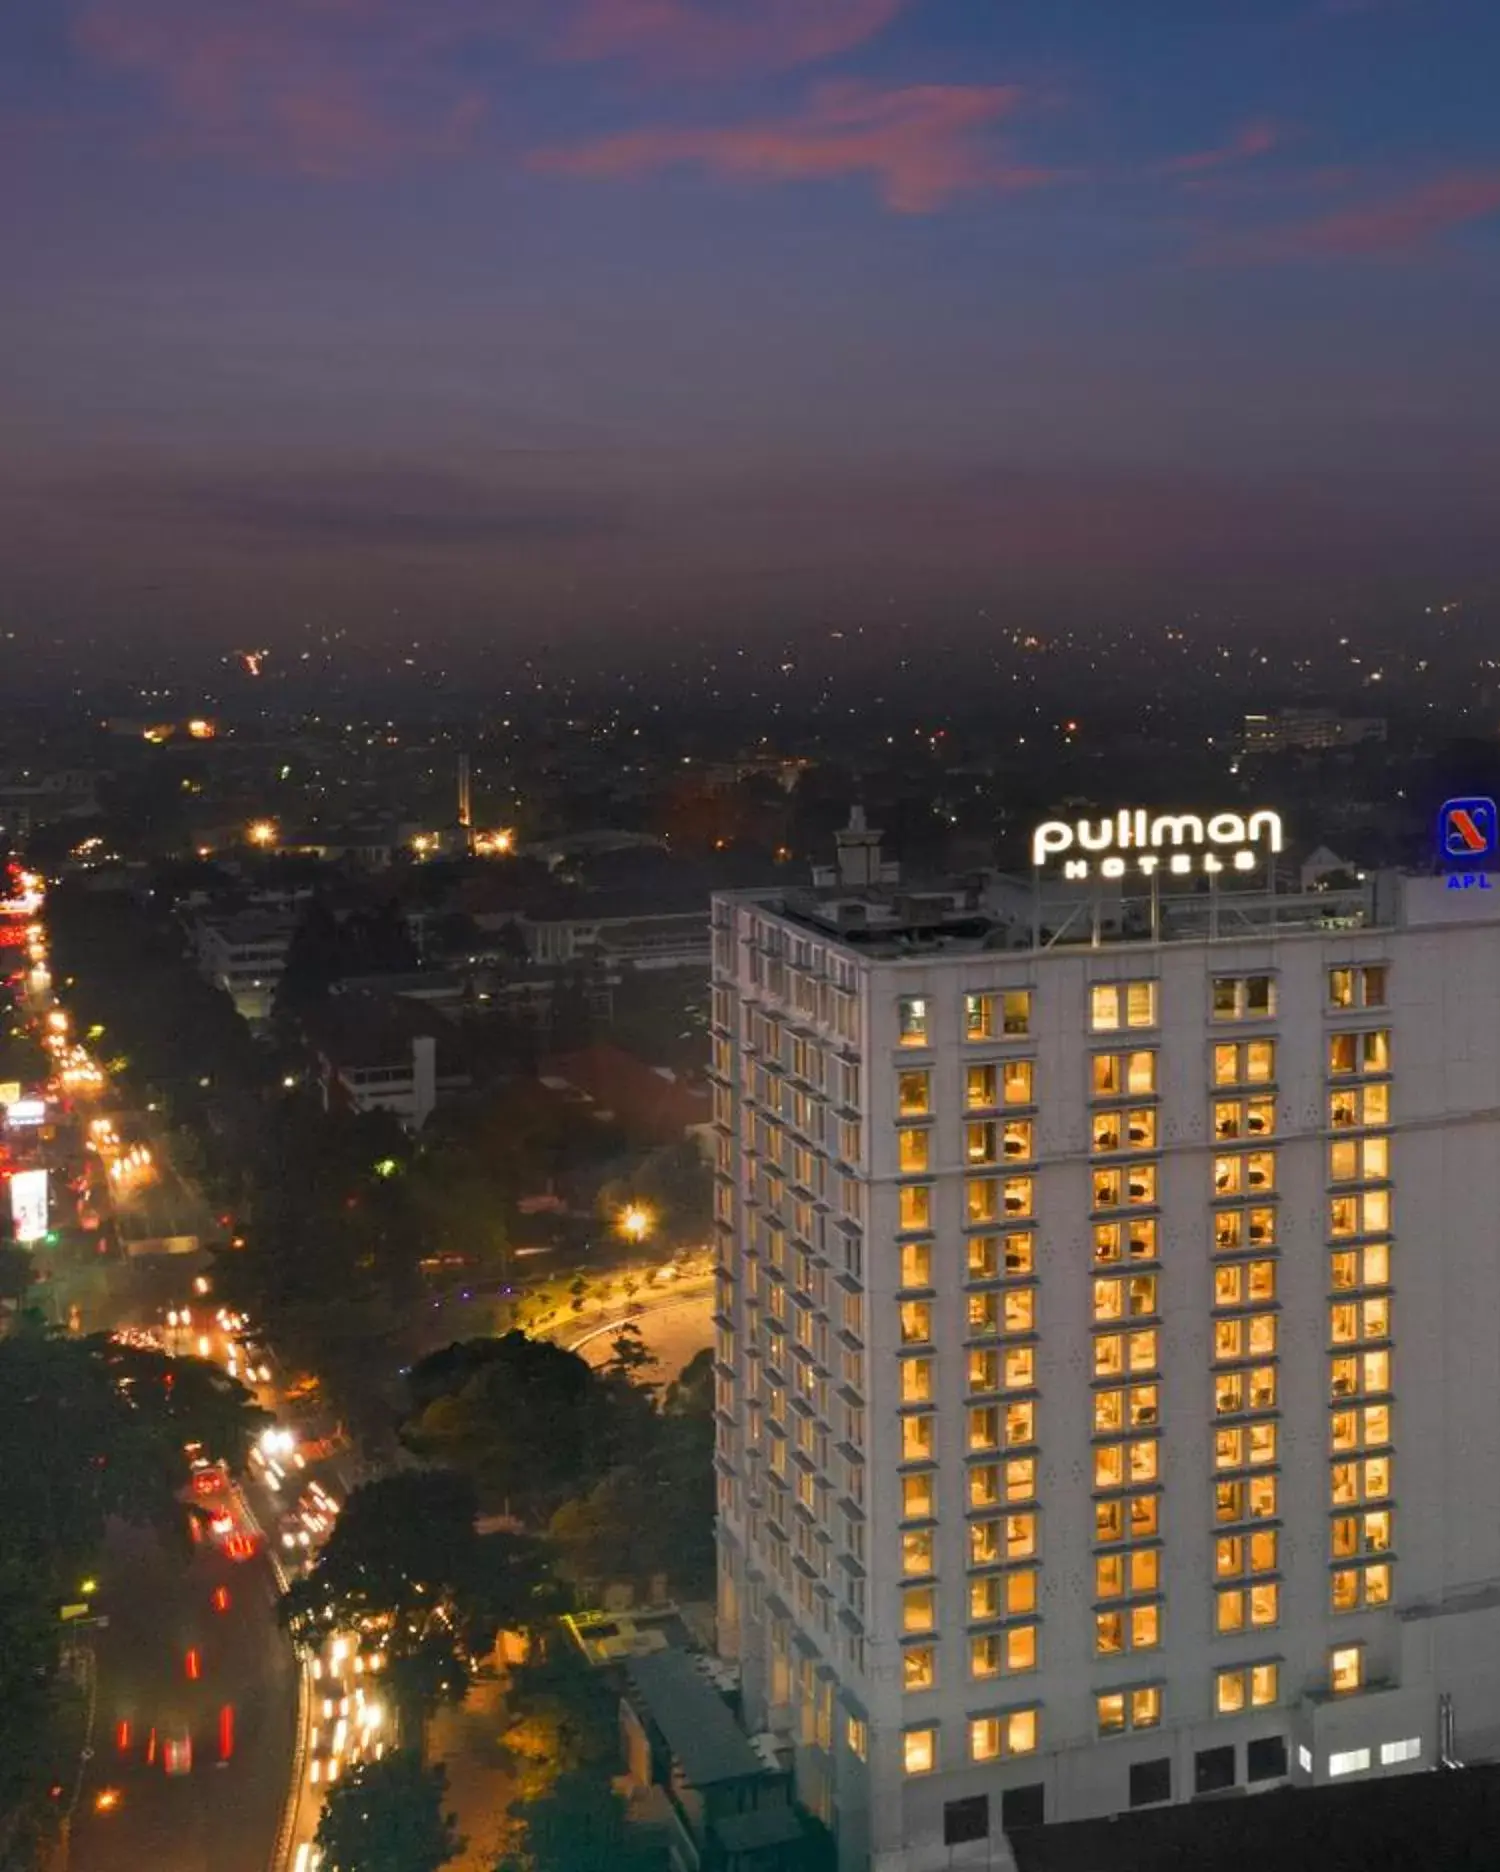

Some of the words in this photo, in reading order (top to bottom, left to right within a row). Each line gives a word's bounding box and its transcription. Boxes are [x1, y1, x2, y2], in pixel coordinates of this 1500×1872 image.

[1033, 809, 1282, 866] pullman
[1065, 851, 1256, 880] HOTELS
[1447, 873, 1493, 889] APL
